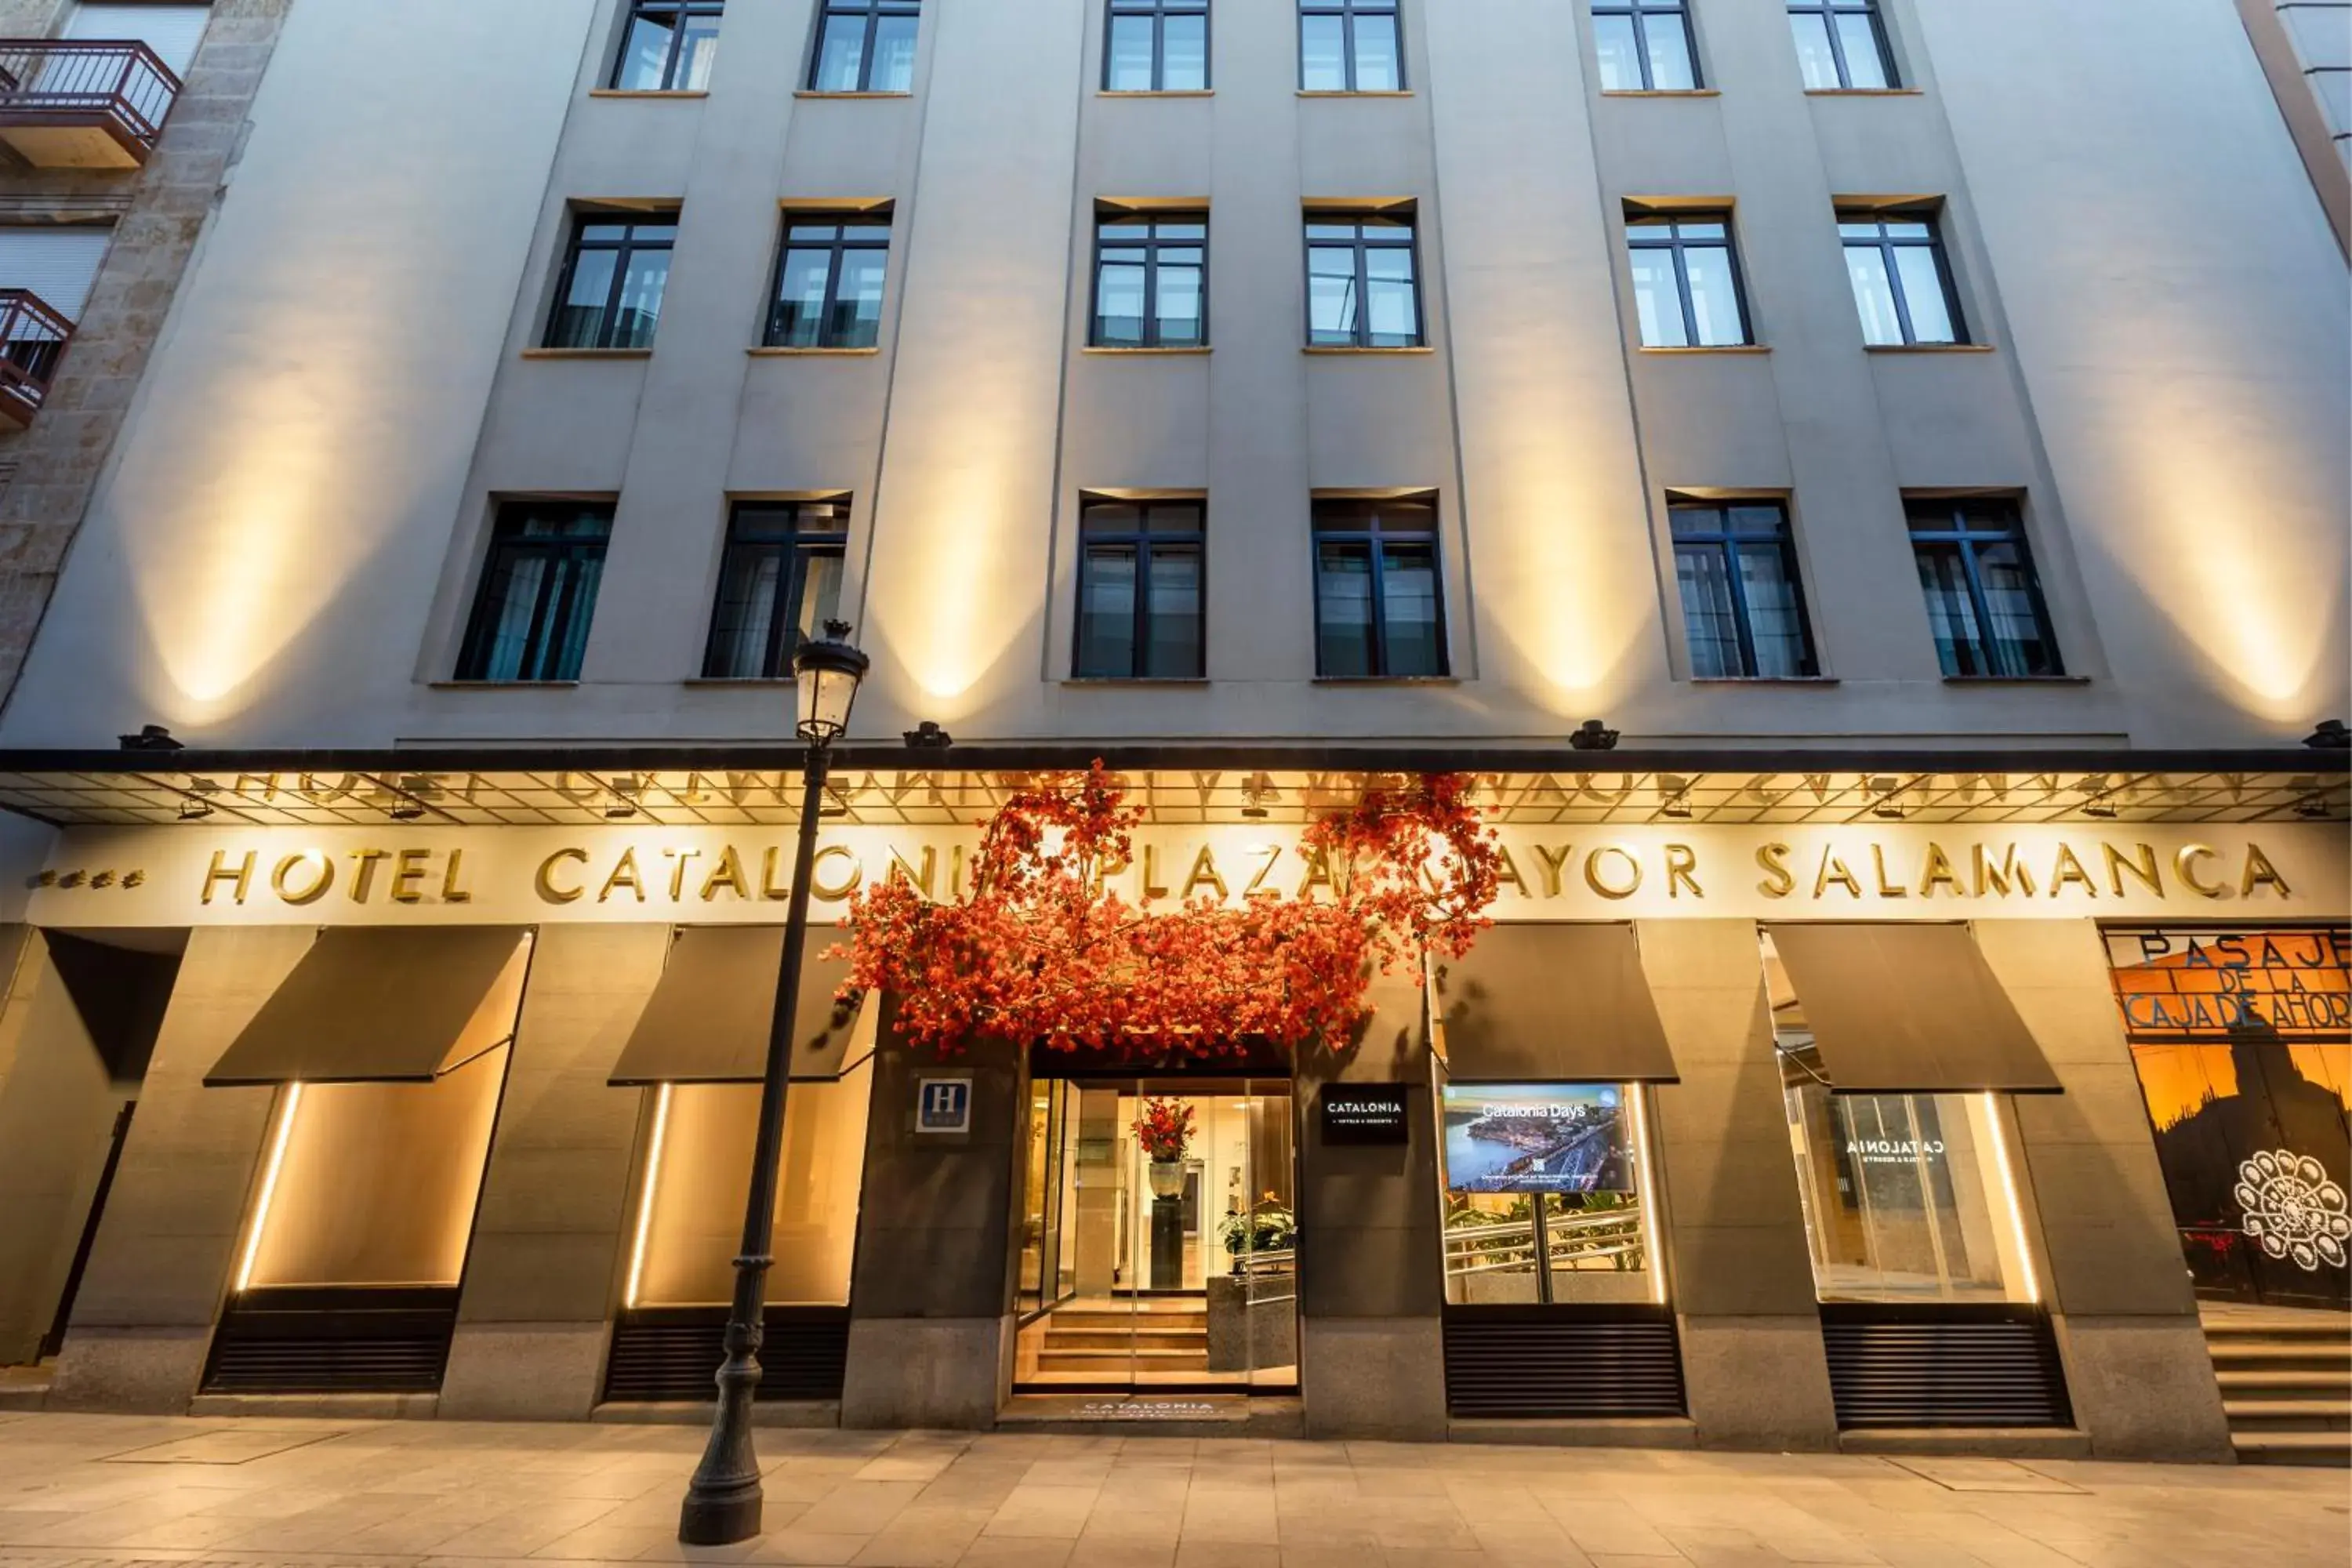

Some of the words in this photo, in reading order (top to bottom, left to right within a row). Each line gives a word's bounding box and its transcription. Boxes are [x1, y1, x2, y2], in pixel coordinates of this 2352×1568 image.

[201, 848, 470, 905] HOTEL
[539, 844, 1019, 902] CATALONI
[1408, 843, 1704, 899] AYOR
[1756, 842, 2292, 899] SALAMANCA
[2218, 967, 2257, 994] DE
[2265, 967, 2307, 995] LA
[2126, 993, 2216, 1028] CAJA
[931, 1086, 957, 1112] H
[1327, 1102, 1402, 1112] CATALONIA
[1483, 1103, 1548, 1118] Catalonia
[1550, 1103, 1587, 1120] Days
